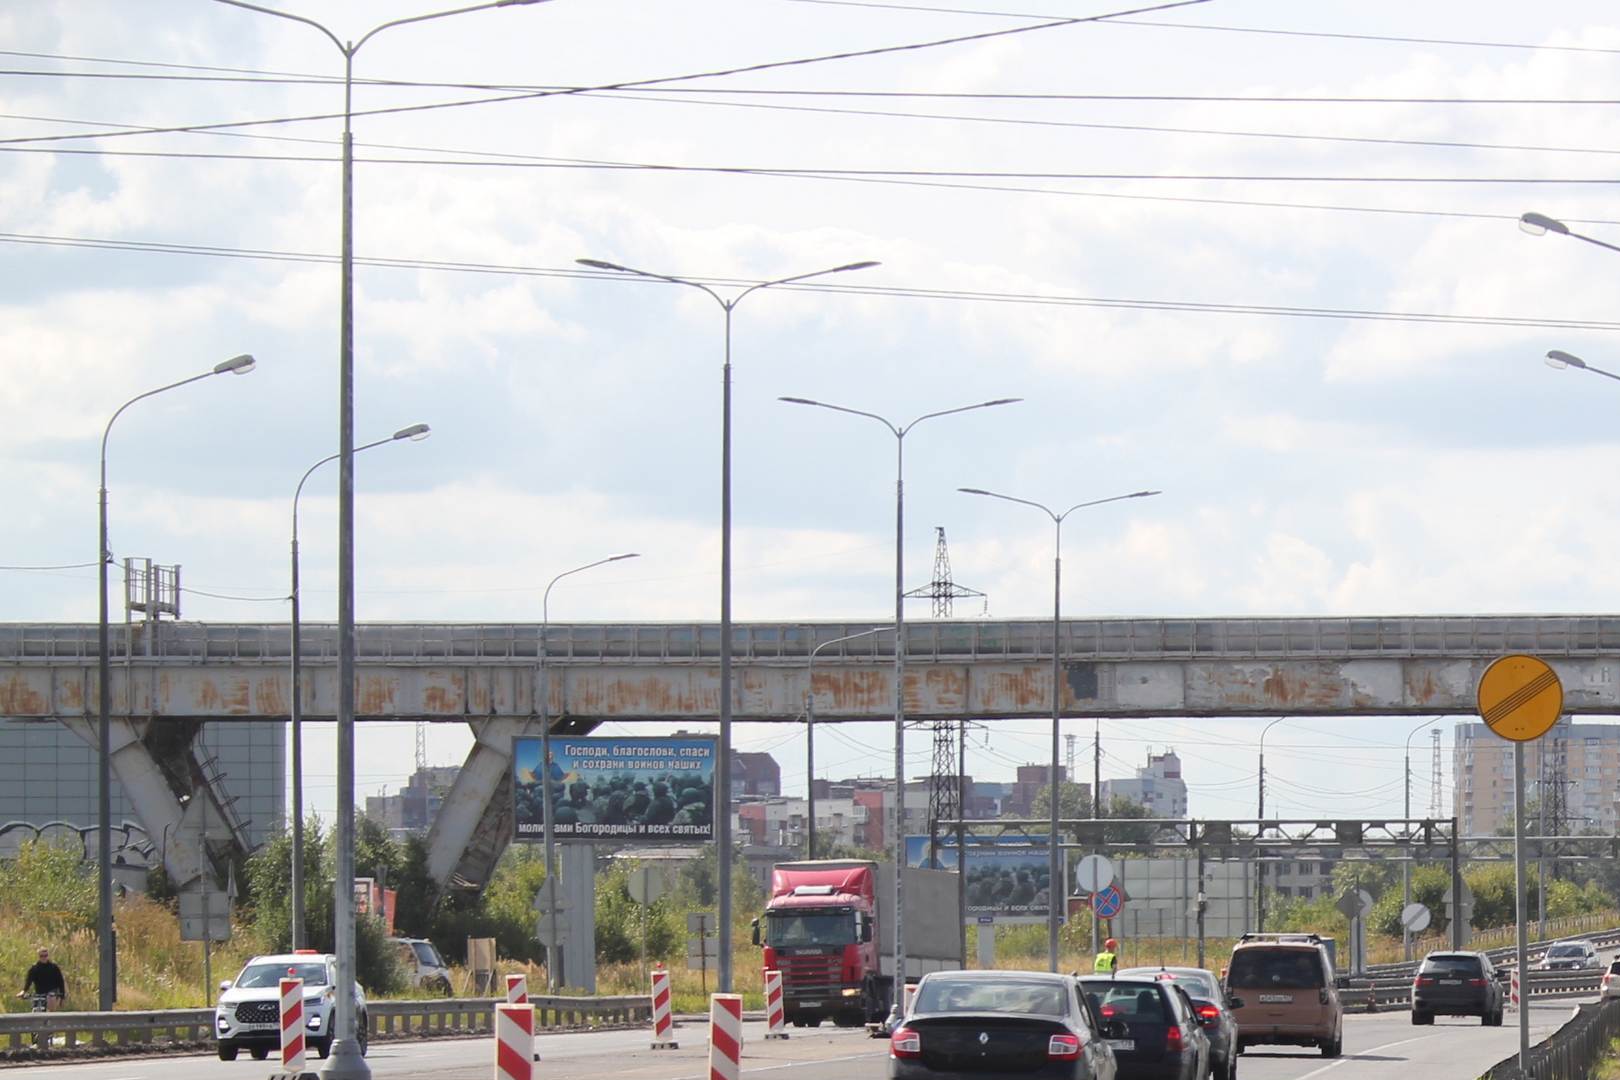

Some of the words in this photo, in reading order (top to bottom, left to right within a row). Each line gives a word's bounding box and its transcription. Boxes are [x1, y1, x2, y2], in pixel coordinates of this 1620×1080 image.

[564, 744, 610, 758] Господи,
[613, 744, 677, 758] благослови,
[679, 747, 710, 757] спаси
[573, 760, 579, 769] и
[582, 760, 625, 771] сохрани
[628, 760, 665, 769] воинов
[668, 760, 702, 769] наших
[518, 823, 574, 833] молиами
[575, 821, 638, 835] Богородицы
[639, 825, 646, 833] и
[648, 824, 671, 834] всех
[672, 824, 711, 834] святых!
